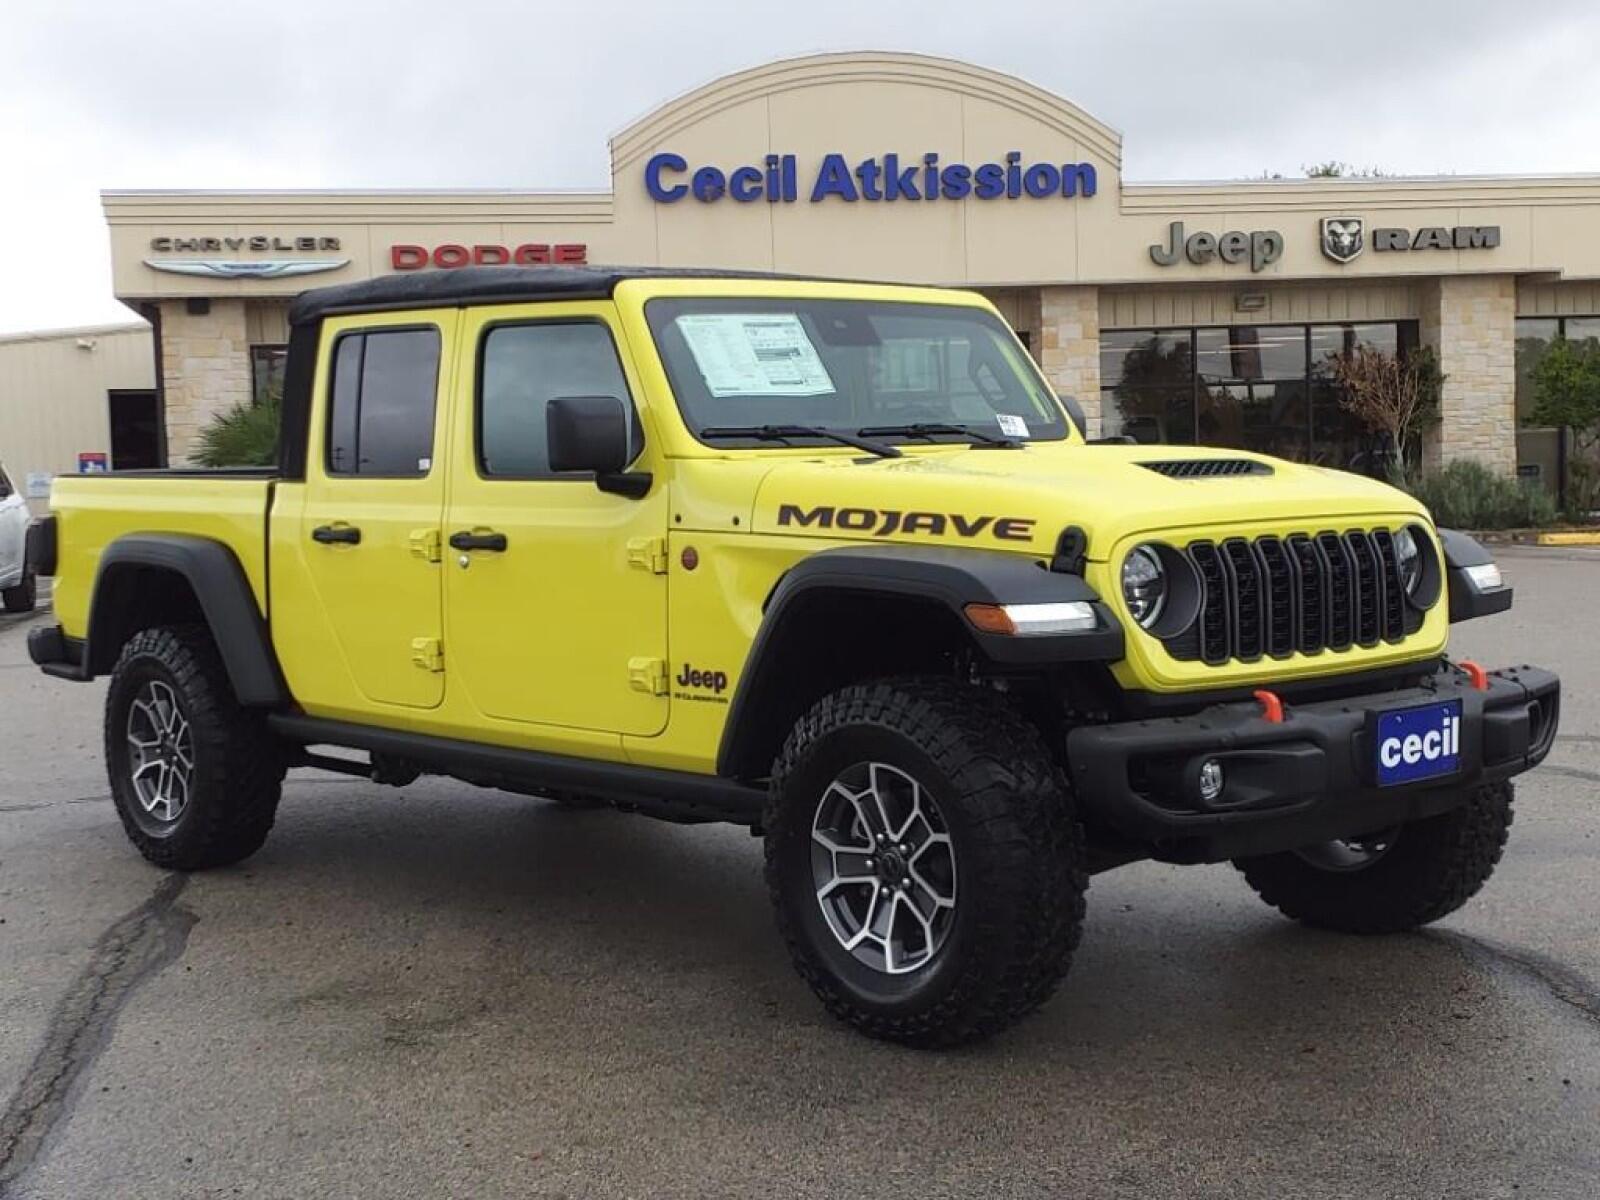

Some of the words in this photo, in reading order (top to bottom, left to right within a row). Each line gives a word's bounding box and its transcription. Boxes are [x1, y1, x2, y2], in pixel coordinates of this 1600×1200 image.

[644, 152, 798, 204] Cecil
[810, 151, 1098, 203] Atkission
[151, 236, 340, 252] CHRYSLER
[1149, 221, 1284, 273] Jeep
[1372, 226, 1501, 251] RAM
[391, 243, 588, 271] DODGE
[777, 504, 1037, 542] MOJAVE
[676, 663, 728, 694] Jeep
[1380, 716, 1459, 768] cecil
